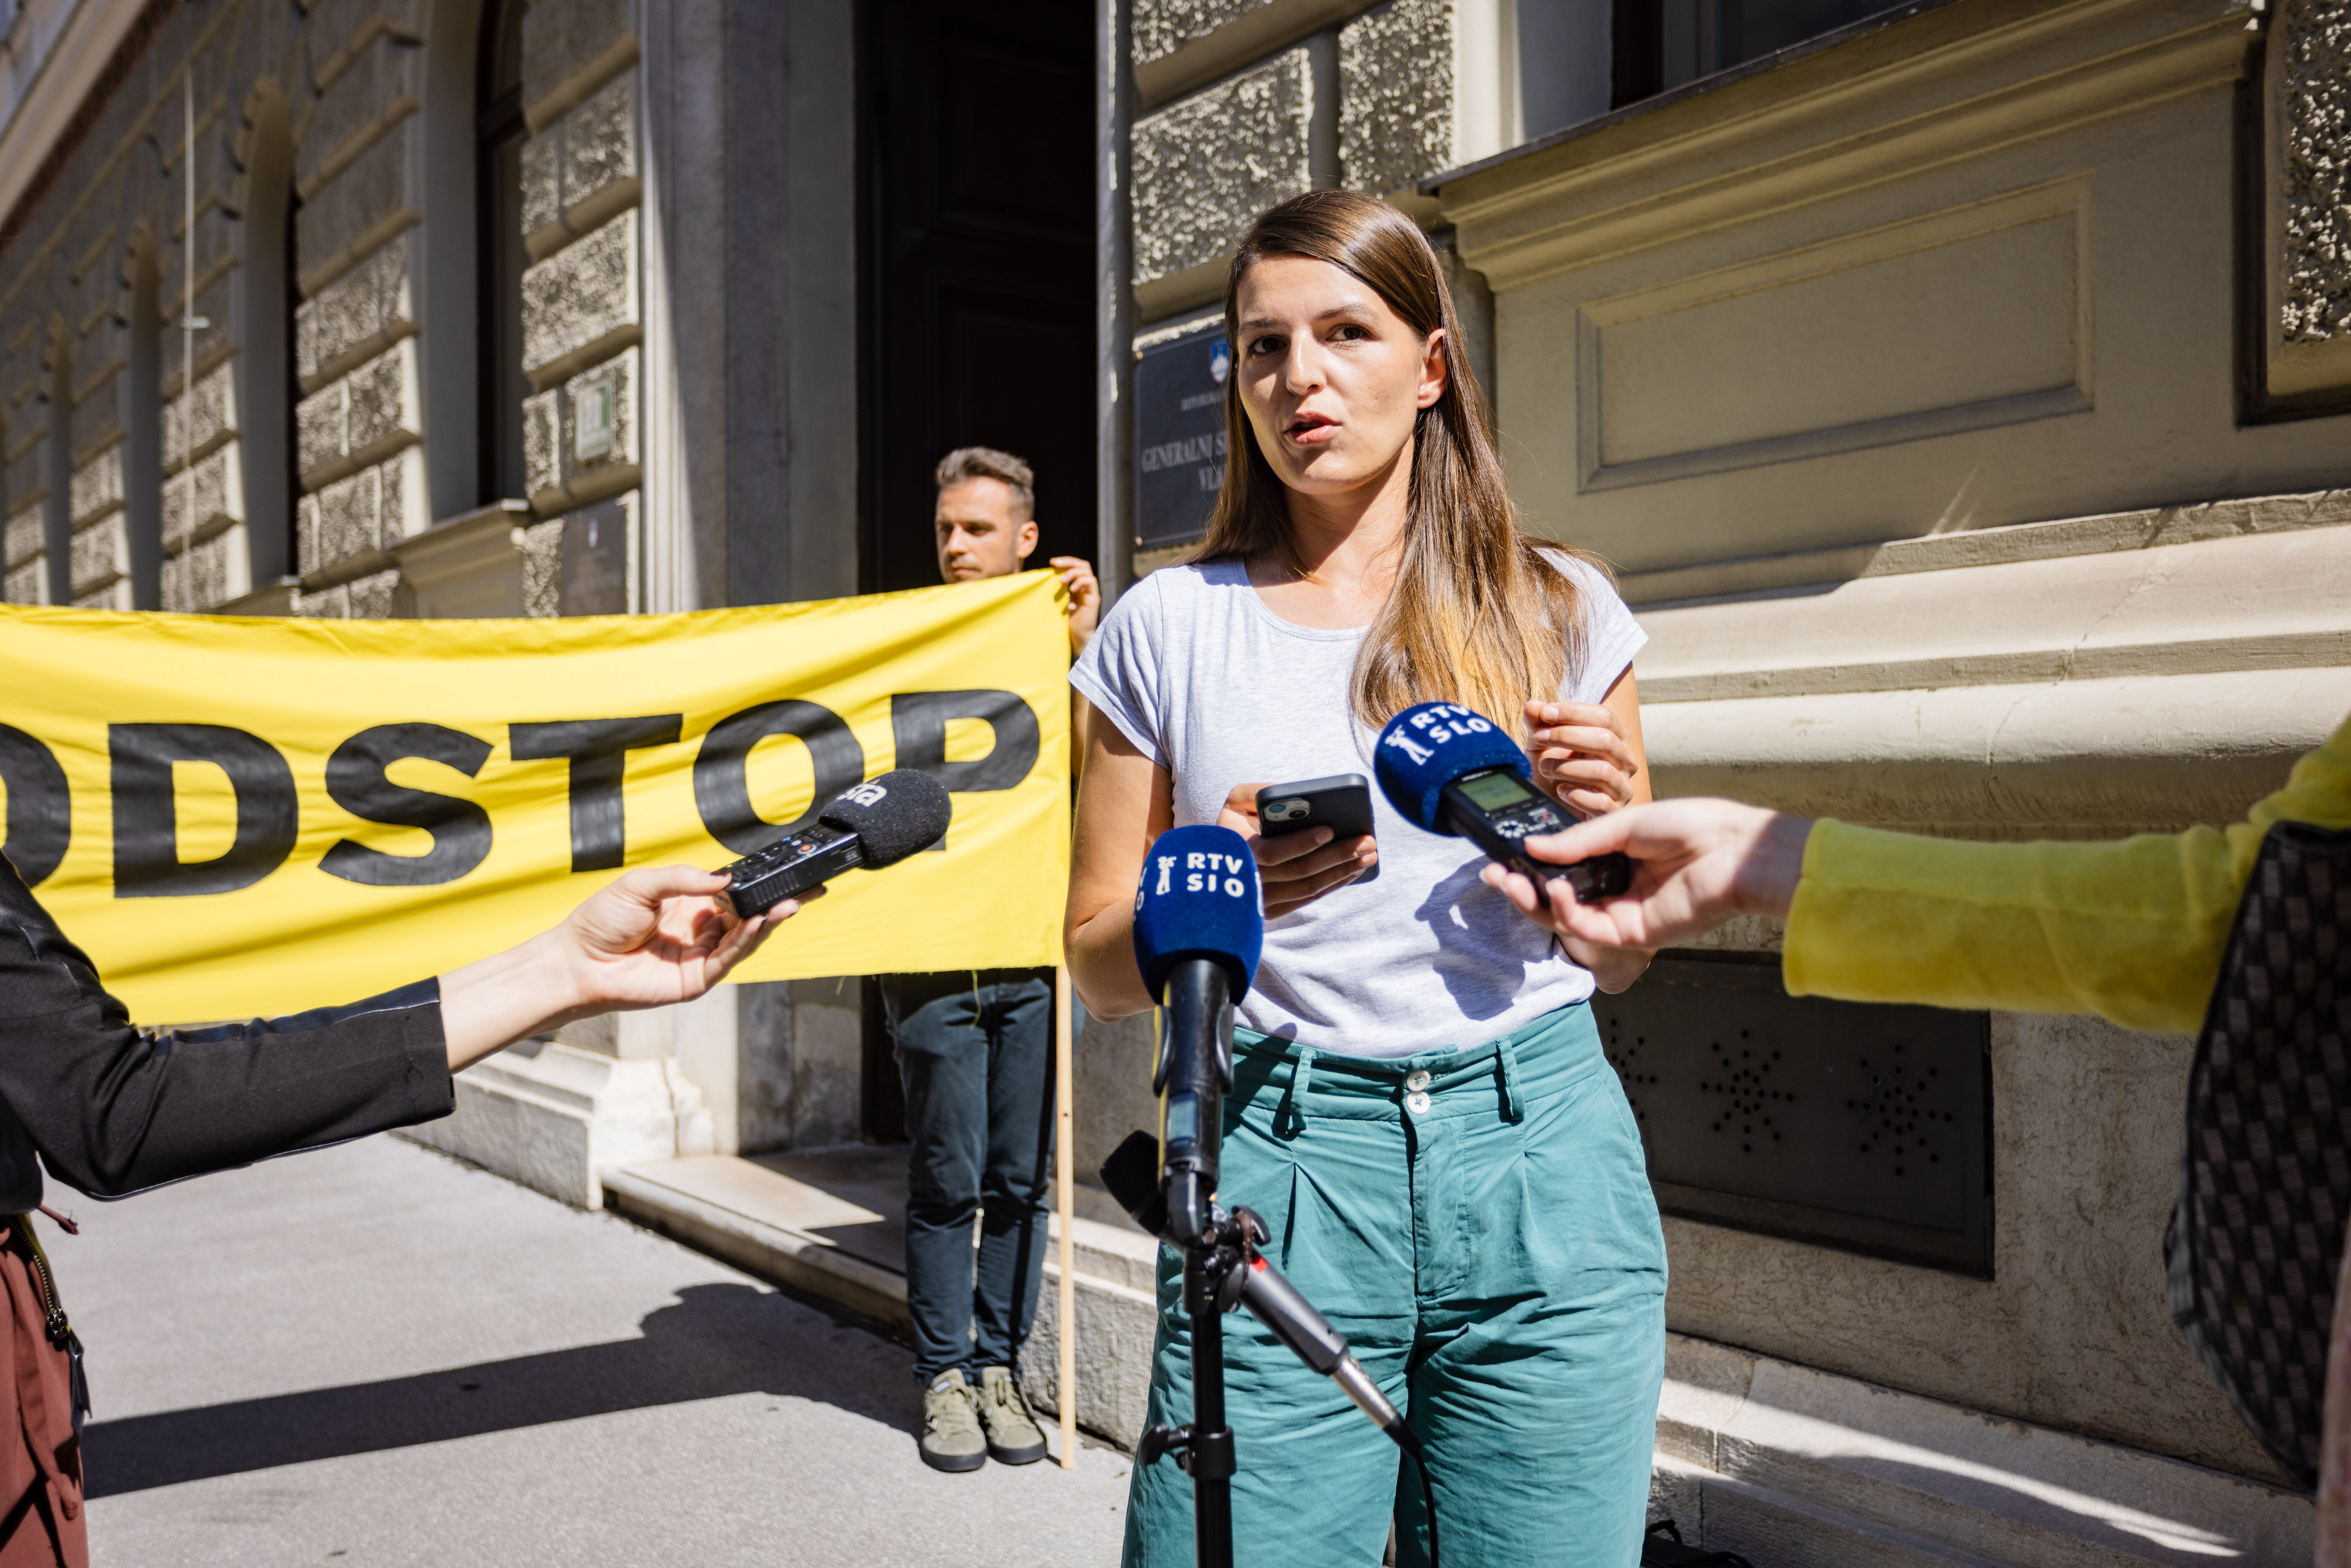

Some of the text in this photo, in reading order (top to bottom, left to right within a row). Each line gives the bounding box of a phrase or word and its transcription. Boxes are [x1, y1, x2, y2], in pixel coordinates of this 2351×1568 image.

[1409, 704, 1470, 729] RTV
[1428, 717, 1492, 744] SLO
[1187, 852, 1243, 875] RTV
